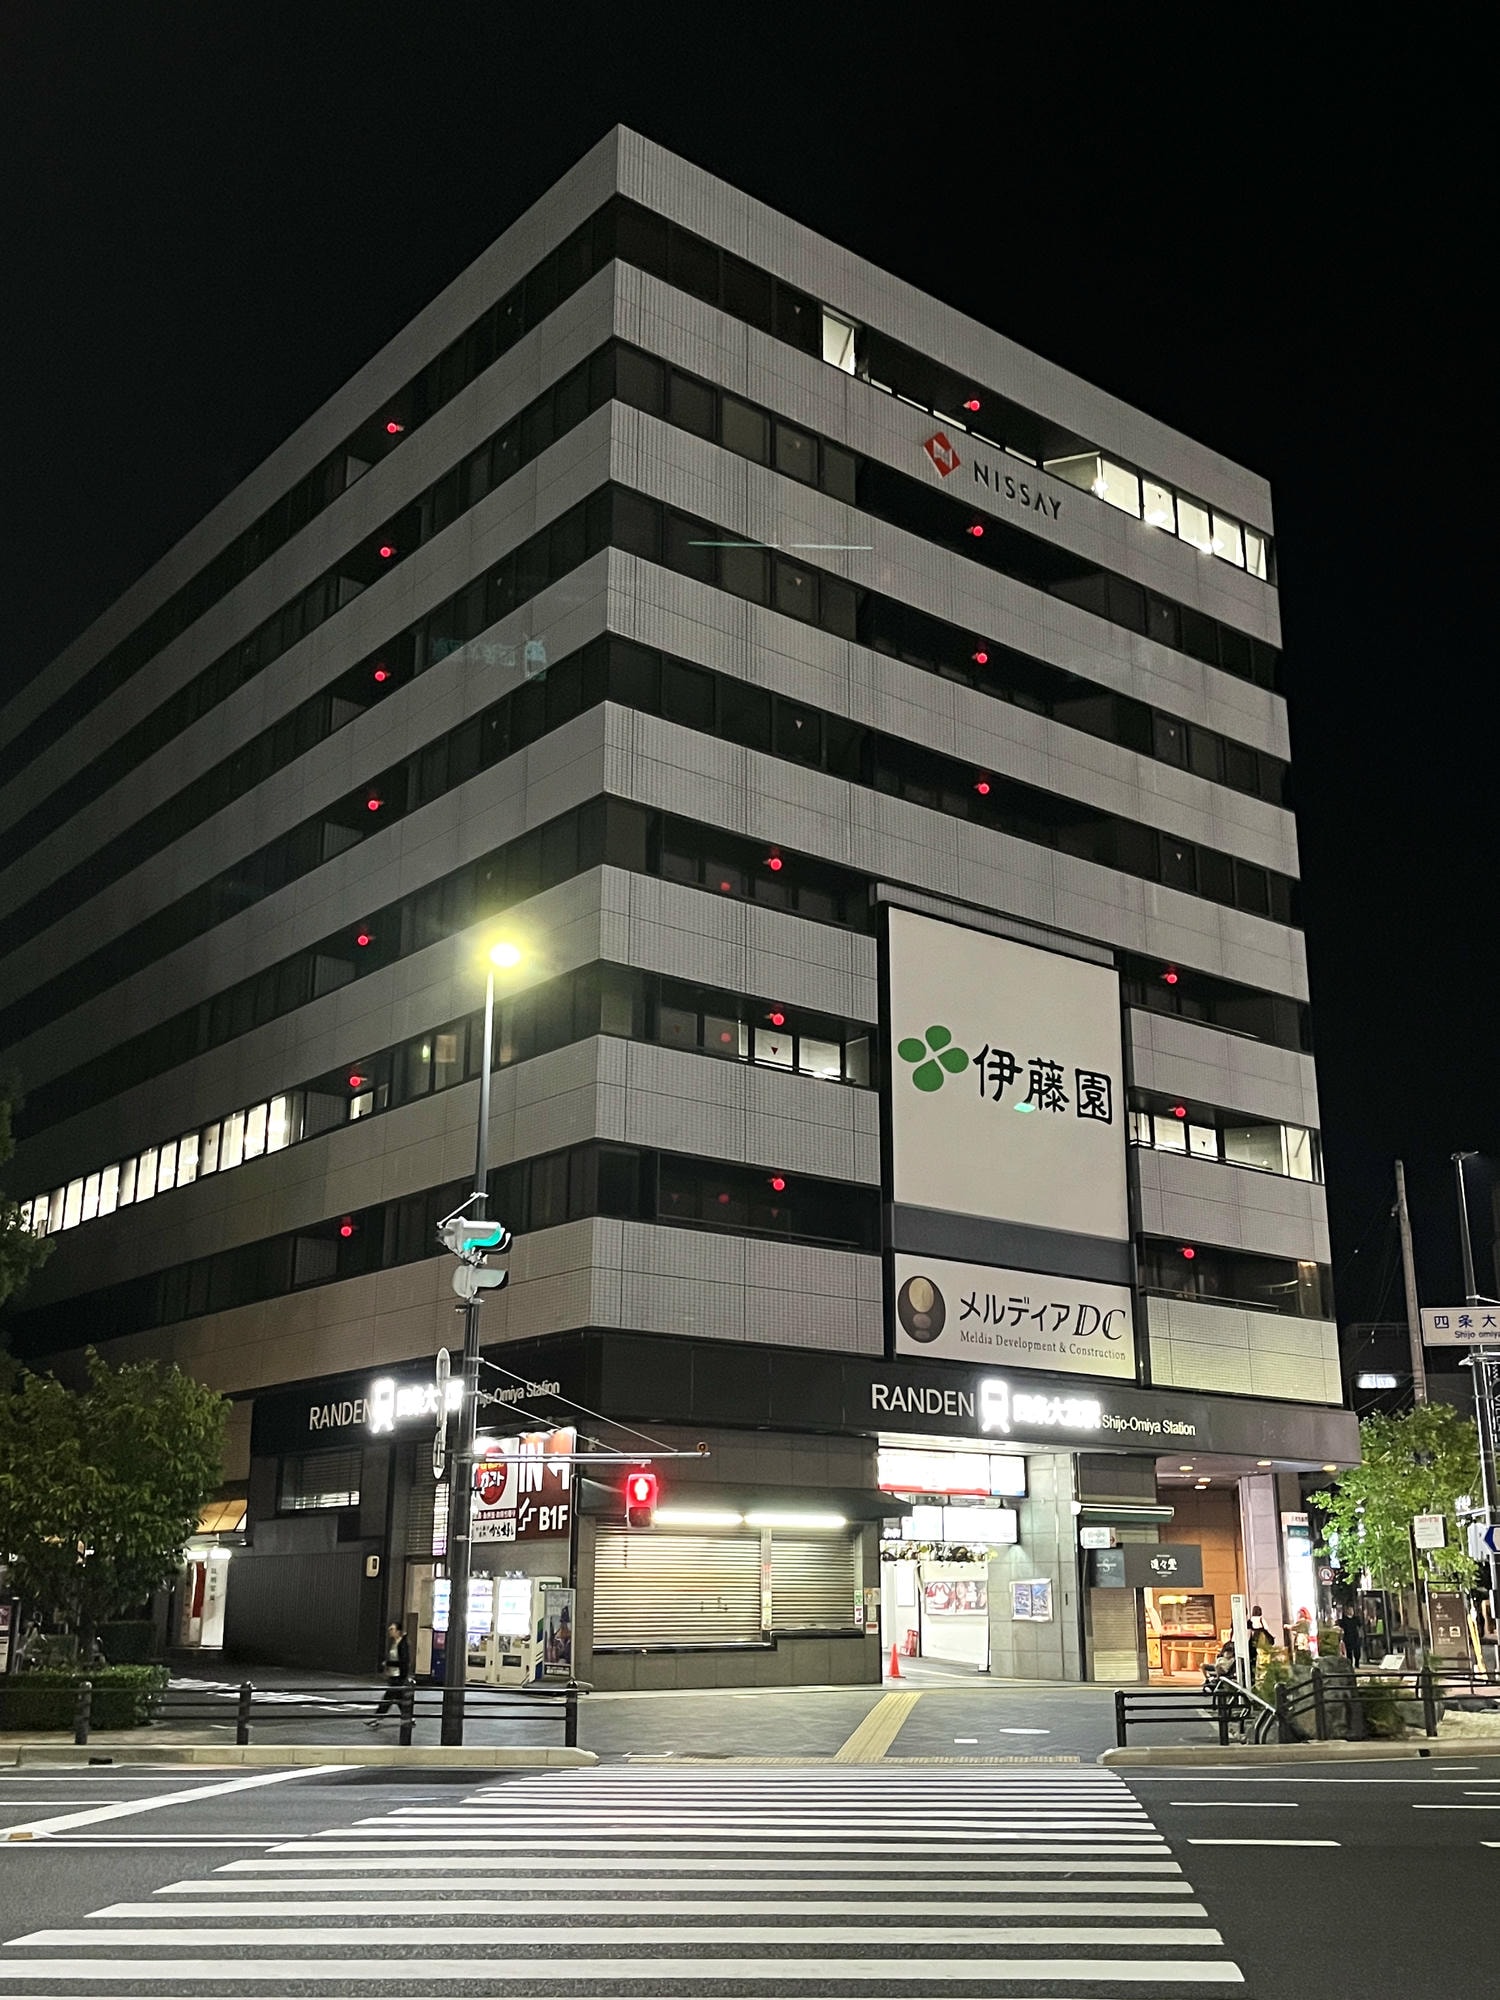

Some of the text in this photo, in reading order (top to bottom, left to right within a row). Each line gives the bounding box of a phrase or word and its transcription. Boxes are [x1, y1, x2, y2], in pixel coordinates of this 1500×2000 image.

[974, 460, 1061, 520] NISSAY
[973, 1043, 1113, 1126] 伊藤園
[960, 1331, 1126, 1360] Meldia Development & Construction
[871, 1384, 974, 1417] RANDEN
[1163, 1419, 1196, 1436] Station
[539, 1505, 569, 1531] B1F
